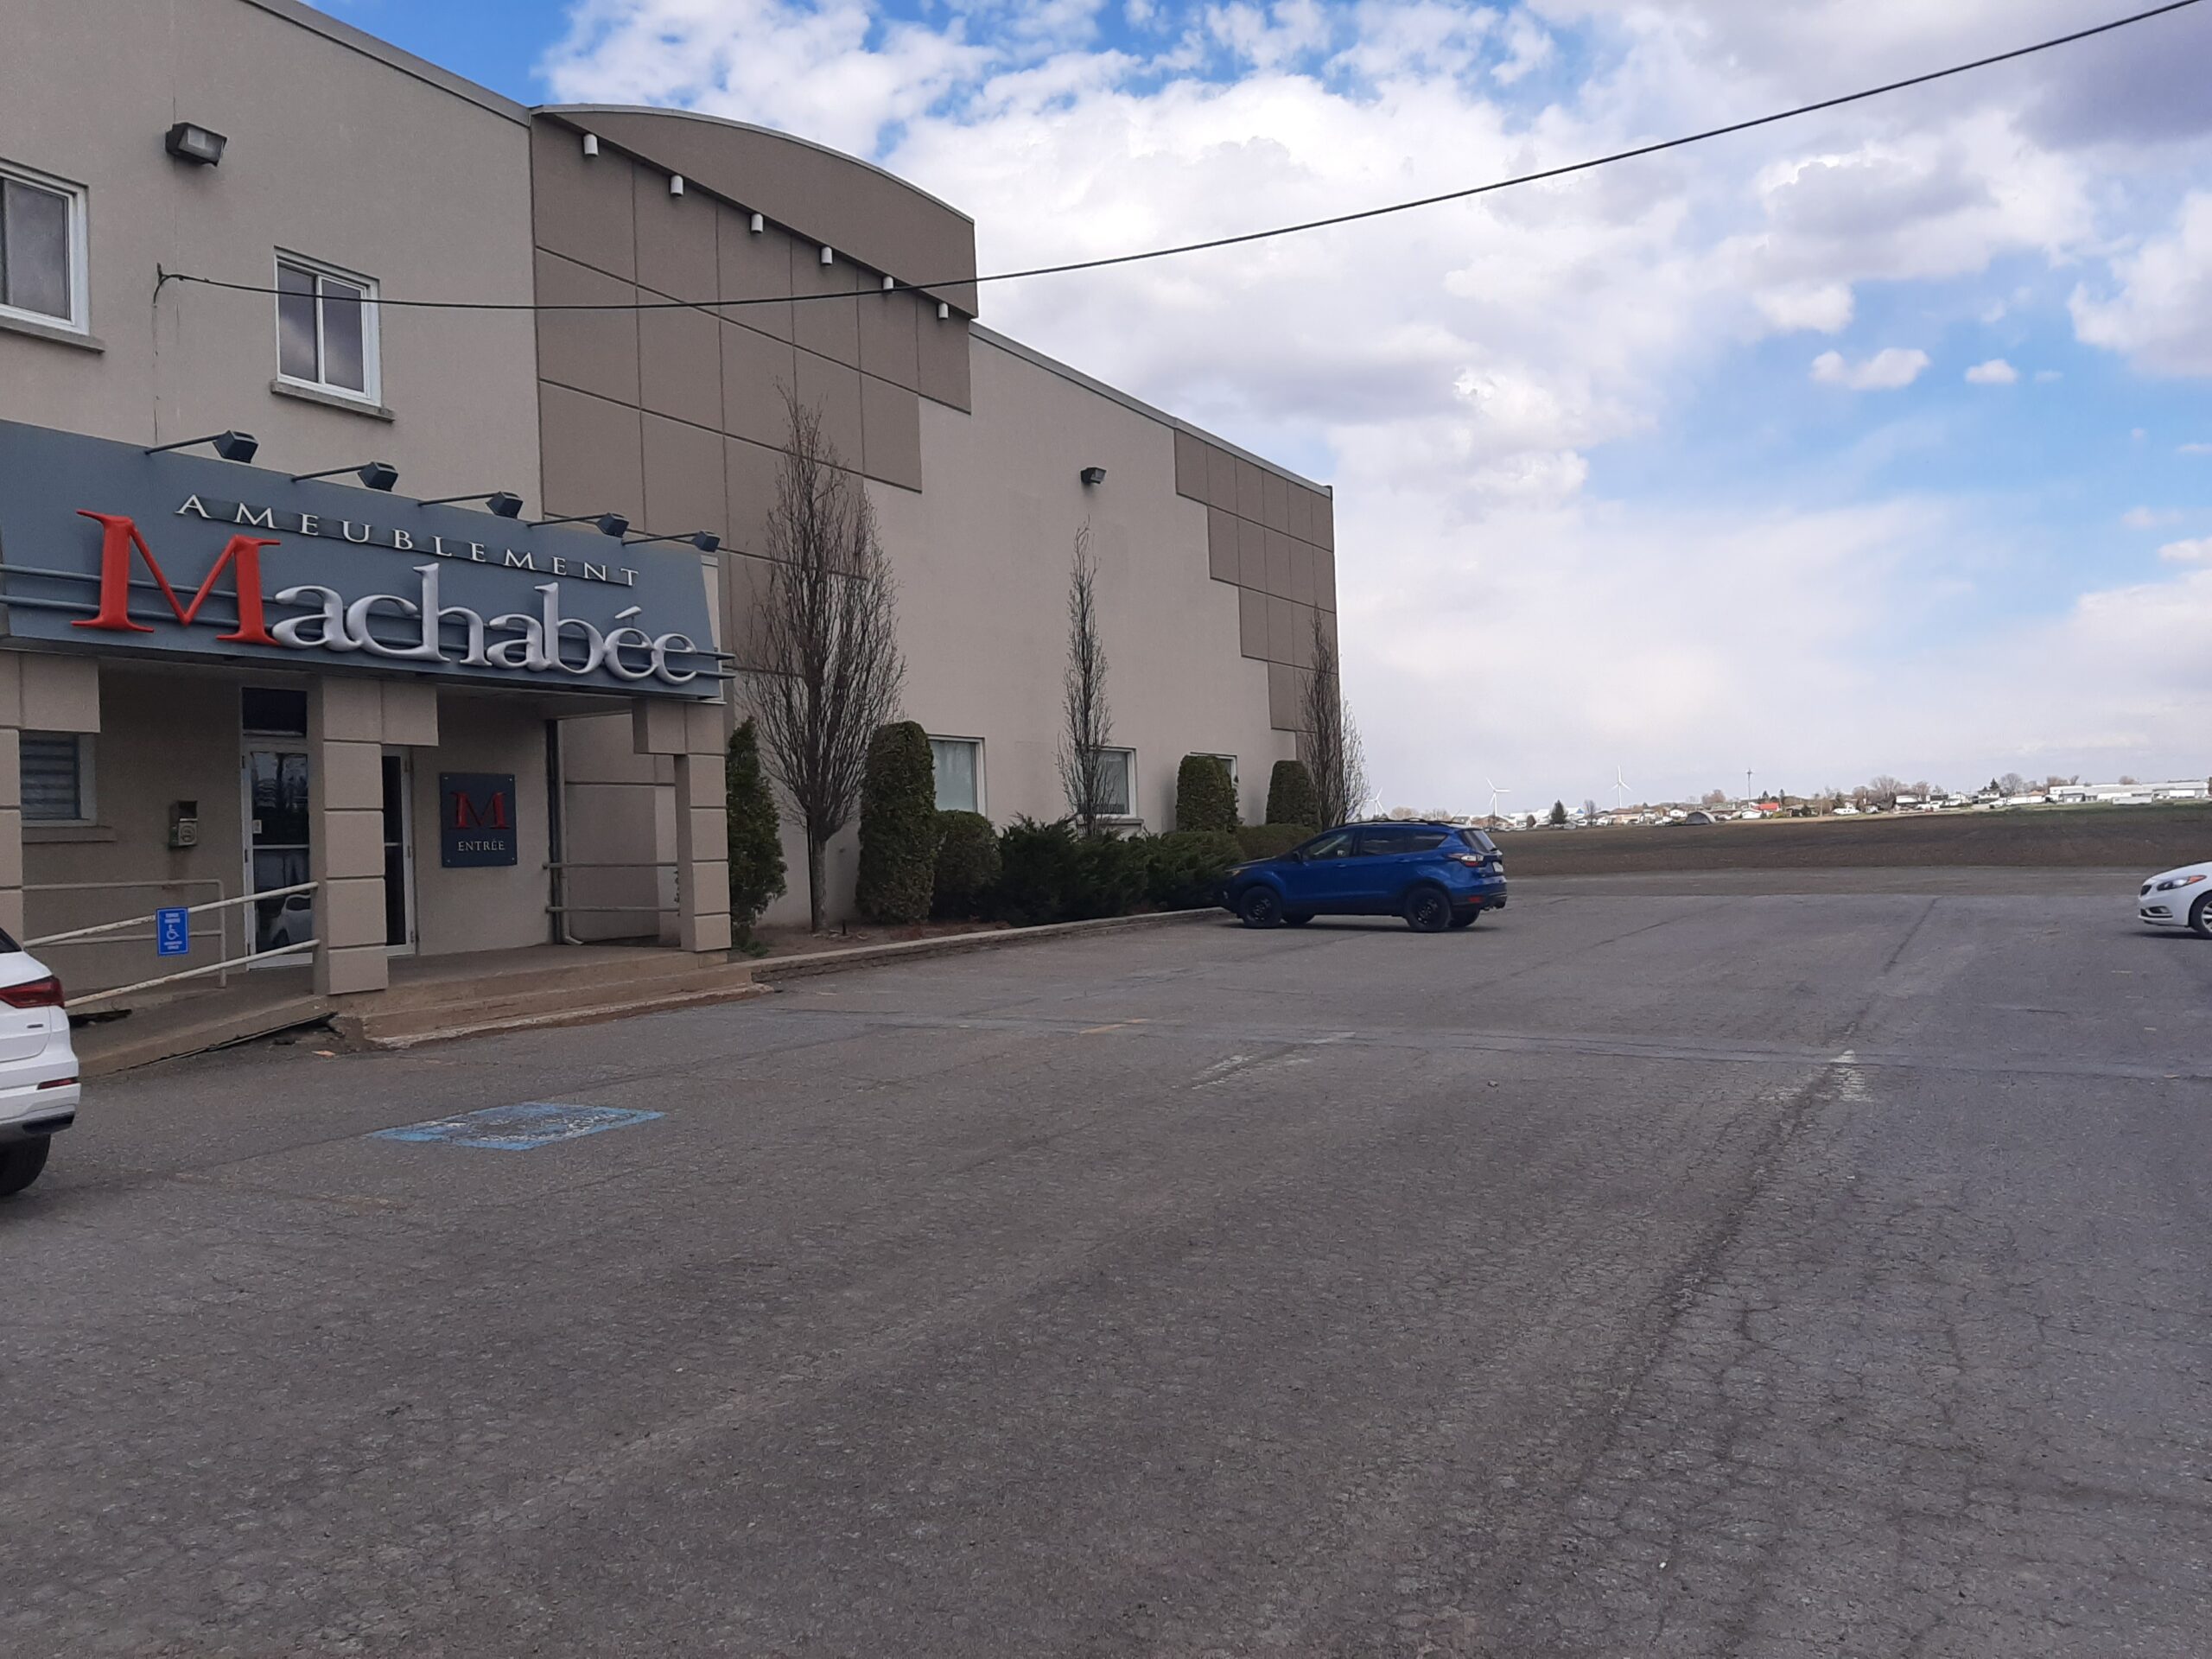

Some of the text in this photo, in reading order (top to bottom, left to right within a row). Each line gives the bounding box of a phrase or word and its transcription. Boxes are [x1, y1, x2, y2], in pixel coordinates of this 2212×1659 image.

[175, 494, 639, 587] AMEUBLEMENT
[70, 508, 697, 685] Machabée
[450, 791, 511, 830] M
[458, 838, 505, 852] ENTRÉE
